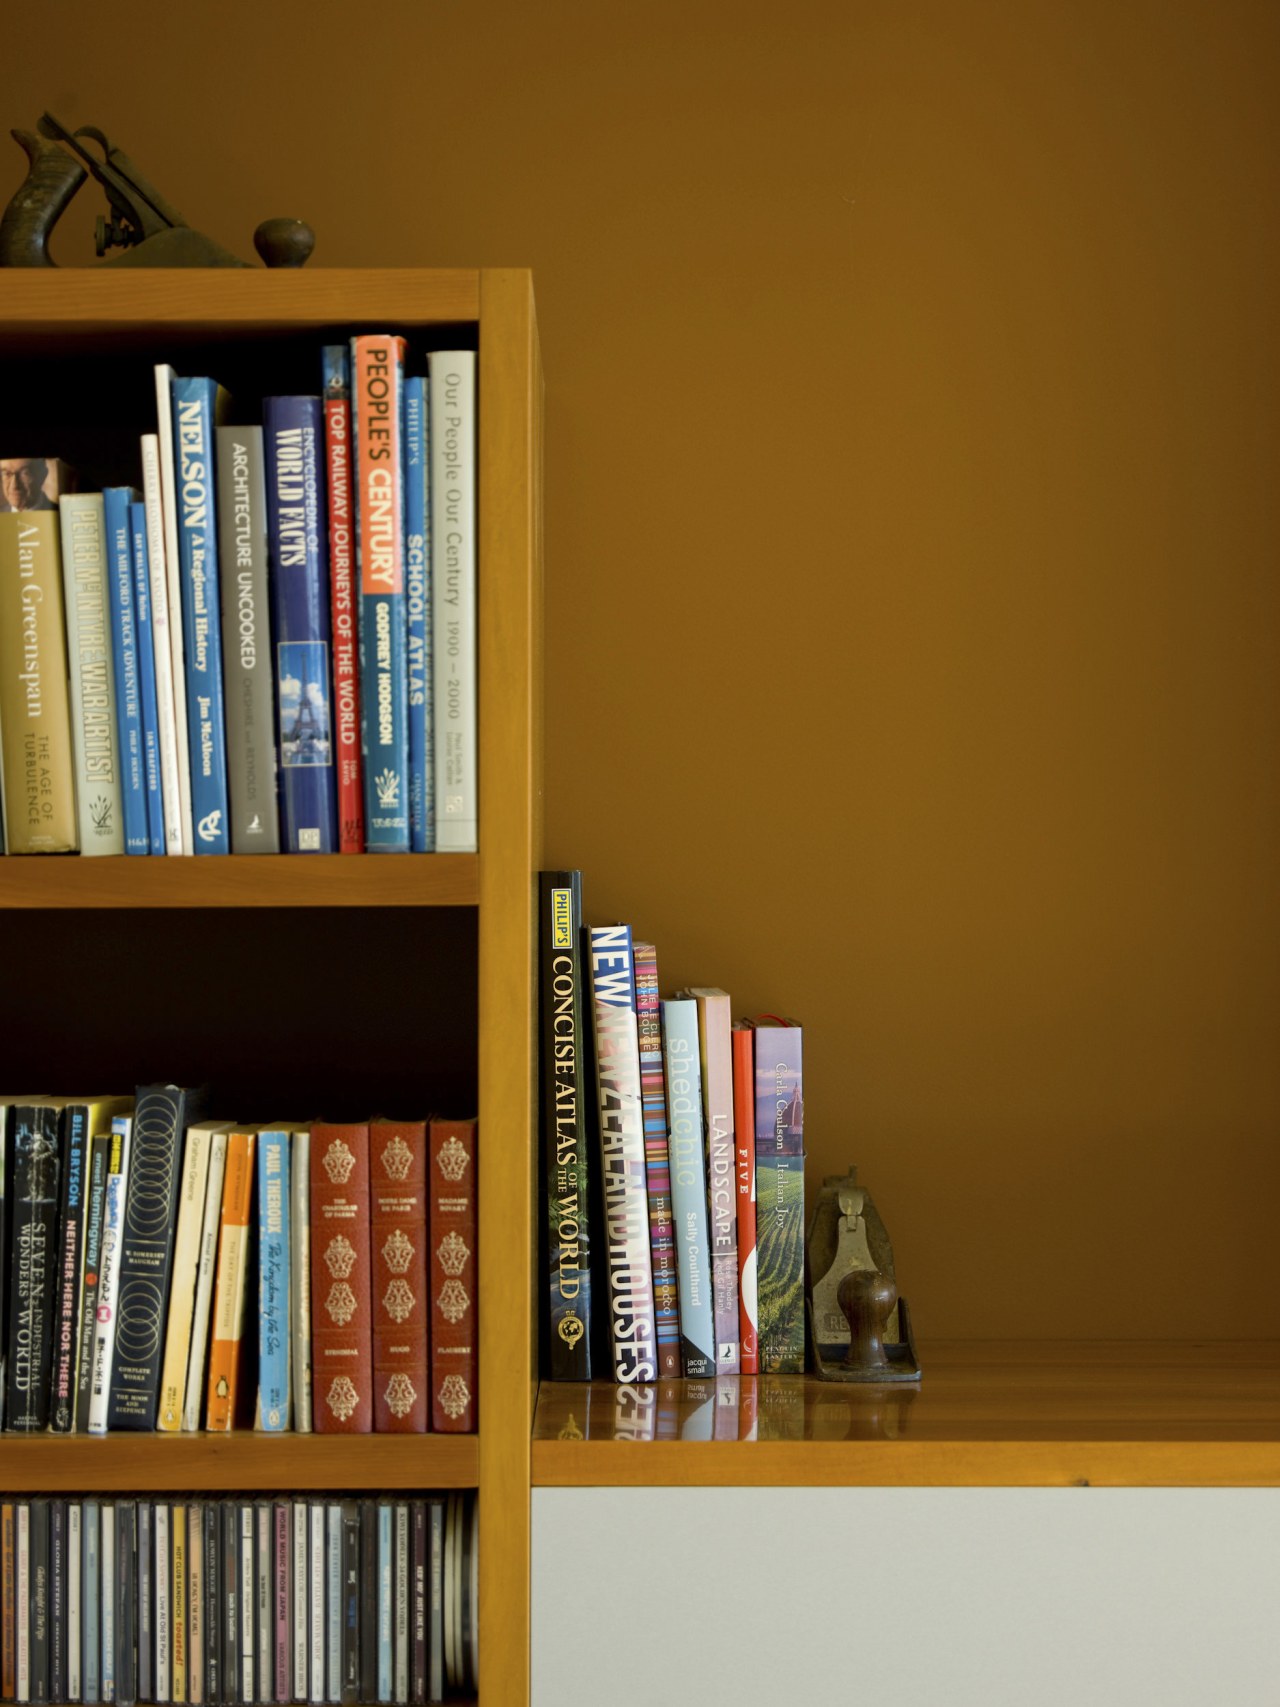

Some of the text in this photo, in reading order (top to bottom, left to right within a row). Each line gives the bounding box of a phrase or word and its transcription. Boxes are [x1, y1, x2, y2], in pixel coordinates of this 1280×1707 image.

[233, 443, 253, 567] ARCHITECTURE
[275, 428, 307, 567] WORLD FACTS
[303, 427, 319, 554] ENCYCLOPEDIA OF
[71, 510, 101, 563] PETER
[116, 527, 128, 551] THE
[136, 552, 146, 580] WALKS
[329, 405, 355, 745] TOP RAILWAY JOURNEYS OF THE WORLD
[366, 349, 394, 745] PEOPLE'S CENTURY GODFREY HODGSON
[408, 398, 424, 706] PHILIP'S SCHOOL ATLAS
[441, 373, 464, 720] Our People Our Century 1900 2000
[17, 520, 46, 719] Alan Greenspan
[117, 554, 131, 605] MILFORD
[139, 594, 148, 622] Nelson
[177, 400, 214, 776] NELSON A Regional History Jim McAloon
[237, 572, 256, 669] UNCOOKED
[120, 608, 134, 647] TRACK
[79, 662, 110, 707] WAR
[123, 649, 138, 718] ADVENTURE
[24, 732, 39, 826] TURBULENCE
[38, 735, 50, 763] THE
[40, 767, 51, 795] AGE
[82, 707, 114, 784] ARTIST
[41, 801, 53, 821] OF
[552, 891, 579, 1190] PHILIP'S CONCISE ATLAS OF
[637, 975, 652, 1059] JOHN BOUGEN
[646, 974, 660, 1058] JULIE LE CLERC
[187, 1137, 201, 1202] Graham Greene
[711, 1114, 731, 1247] LANDSCAPE
[738, 1149, 750, 1194] FIVE
[774, 1062, 790, 1228] Carla Coulson Italian Joy
[30, 1222, 47, 1298] SEVEN
[59, 1115, 83, 1398] BILL BRYSON NEITHER HERE NOR THERE
[203, 1232, 214, 1276] Animal Farm
[263, 1144, 282, 1356] PAUL THEROUX The Kingdom by the Sea
[557, 1168, 581, 1300] THE WORLD
[655, 1197, 672, 1316] made in morocco
[685, 1212, 699, 1242] Sally
[15, 1223, 31, 1391] WONDERS WORLD
[79, 1153, 105, 1390] ernest hemingway The Old Man and the Sea
[688, 1245, 702, 1306] Coulthard
[725, 1260, 734, 1310] Rose Thodey
[31, 1309, 44, 1390] INDUSTRIAL
[687, 1358, 708, 1367] jacqui
[687, 1367, 706, 1375] small
